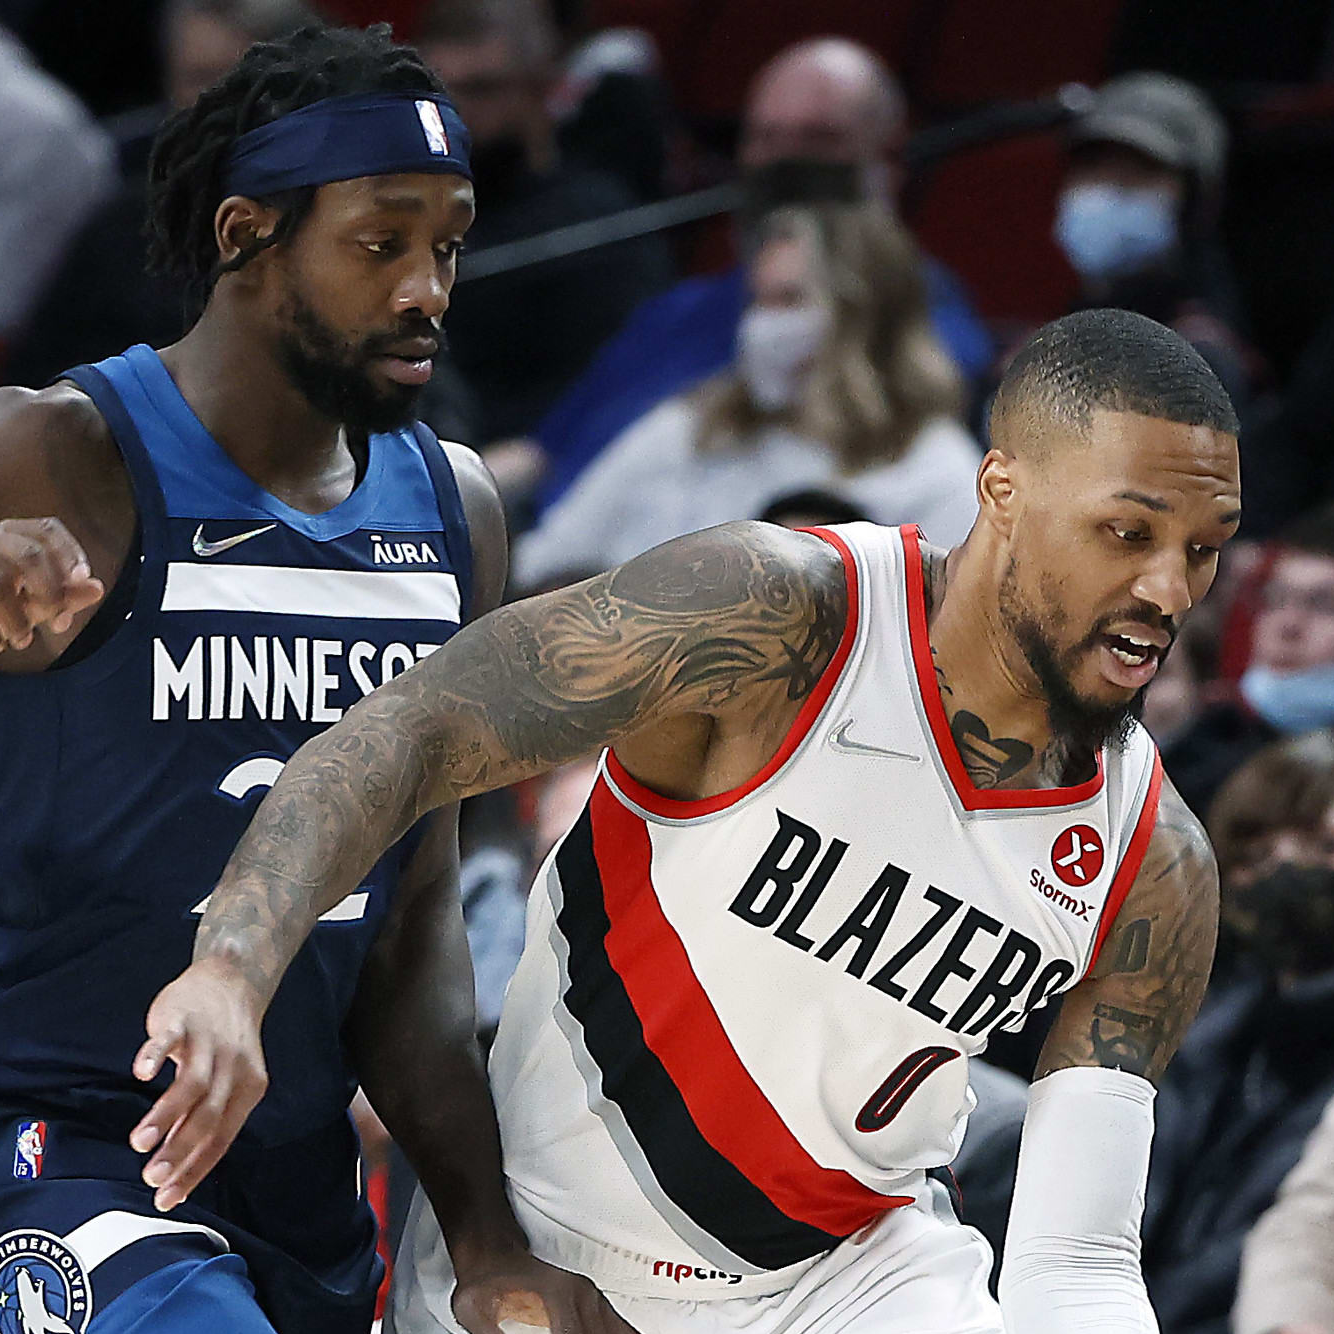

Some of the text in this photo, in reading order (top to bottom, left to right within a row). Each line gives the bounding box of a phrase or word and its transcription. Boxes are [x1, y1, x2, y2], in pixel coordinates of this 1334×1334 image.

[727, 807, 1075, 1036] BLAZERS
[1029, 868, 1096, 923] StormX
[855, 1045, 962, 1133] 0
